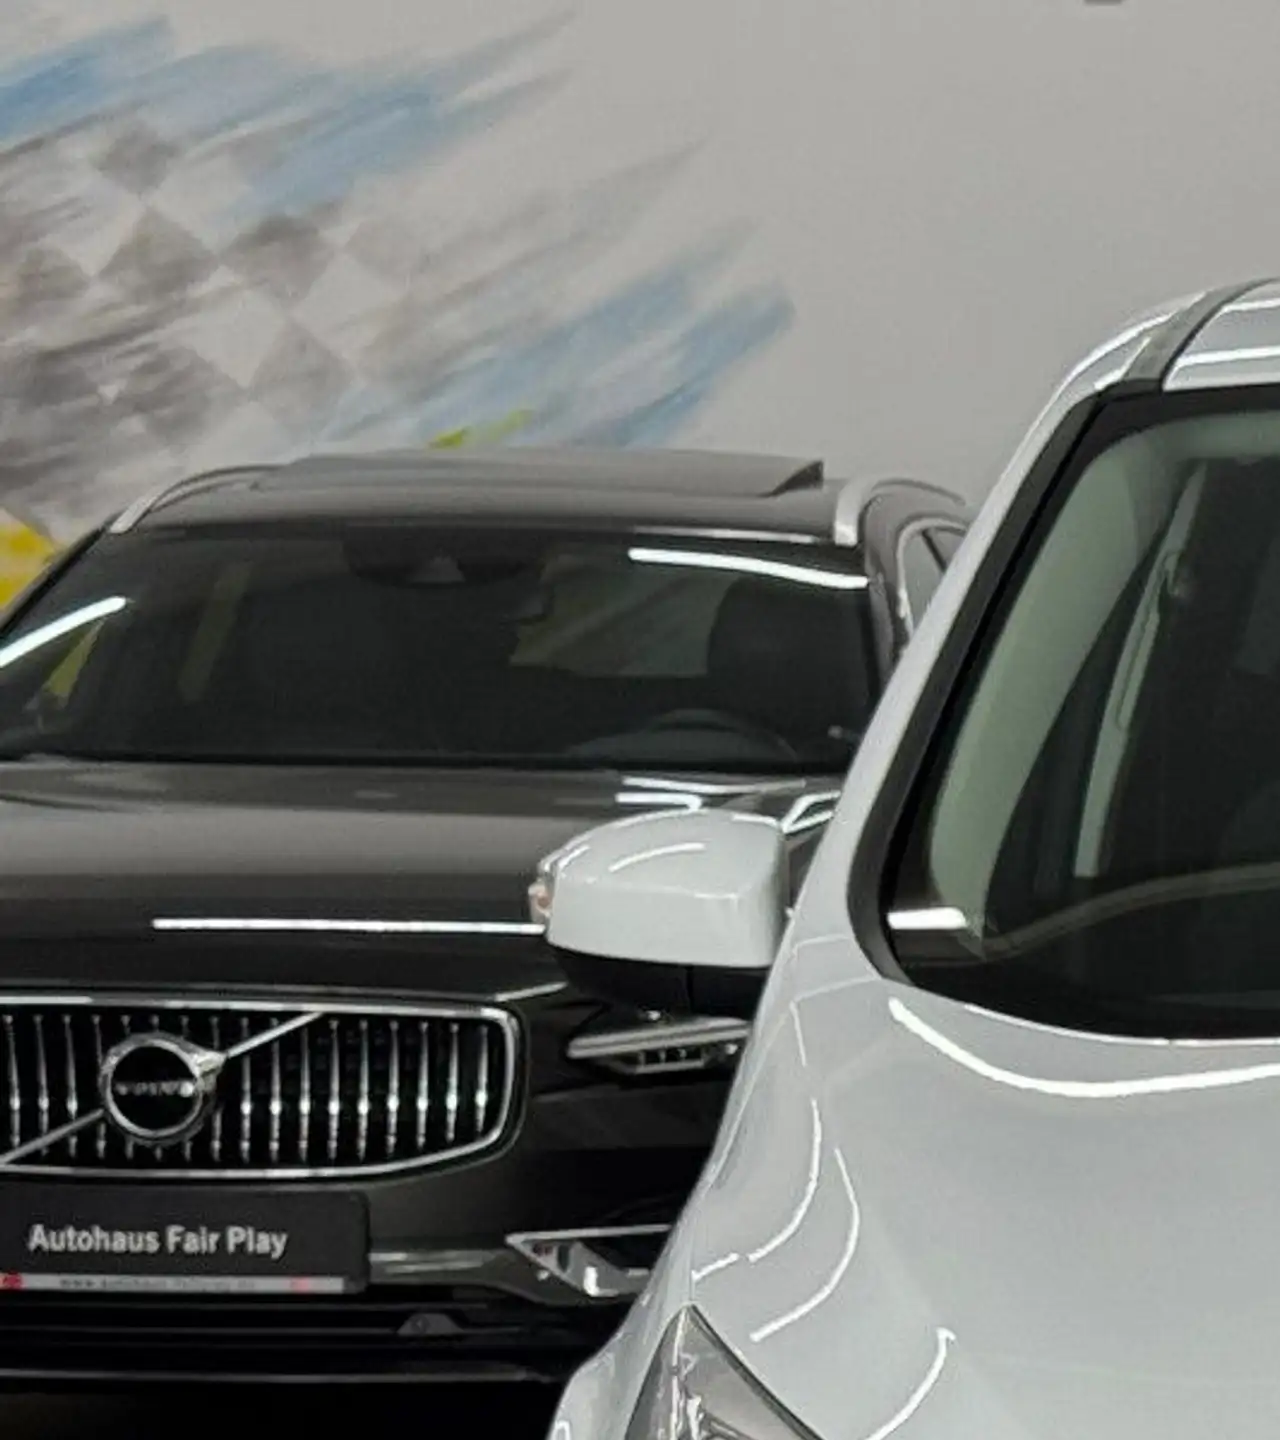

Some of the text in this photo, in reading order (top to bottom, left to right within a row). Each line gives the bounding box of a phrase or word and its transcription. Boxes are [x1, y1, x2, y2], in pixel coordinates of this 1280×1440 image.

[28, 1223, 289, 1259] Autohaus Fair Play
